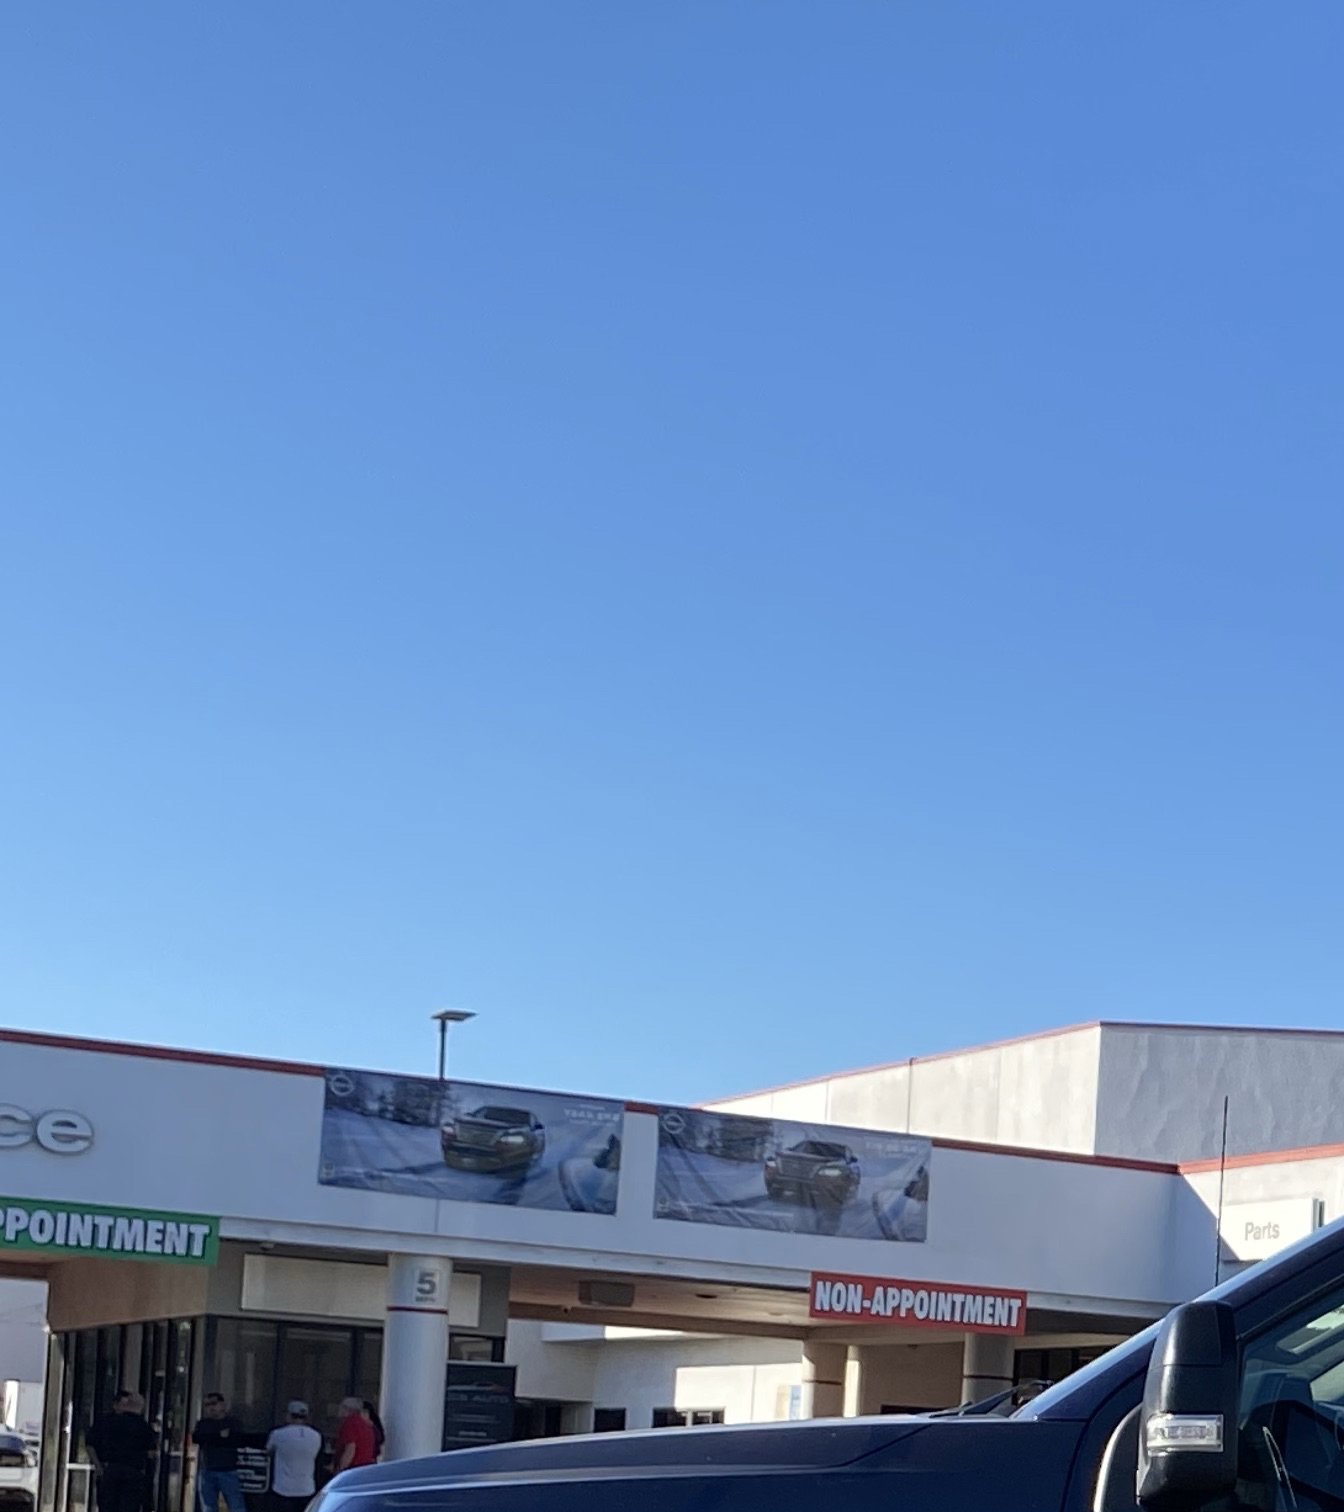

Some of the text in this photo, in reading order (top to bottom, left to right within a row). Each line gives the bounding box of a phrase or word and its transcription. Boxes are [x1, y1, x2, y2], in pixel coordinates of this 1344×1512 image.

[0, 1206, 210, 1258] POINTMENT
[1244, 1221, 1281, 1241] Parts
[416, 1271, 437, 1295] 5
[814, 1279, 1022, 1328] NON-APPOINTMENT
